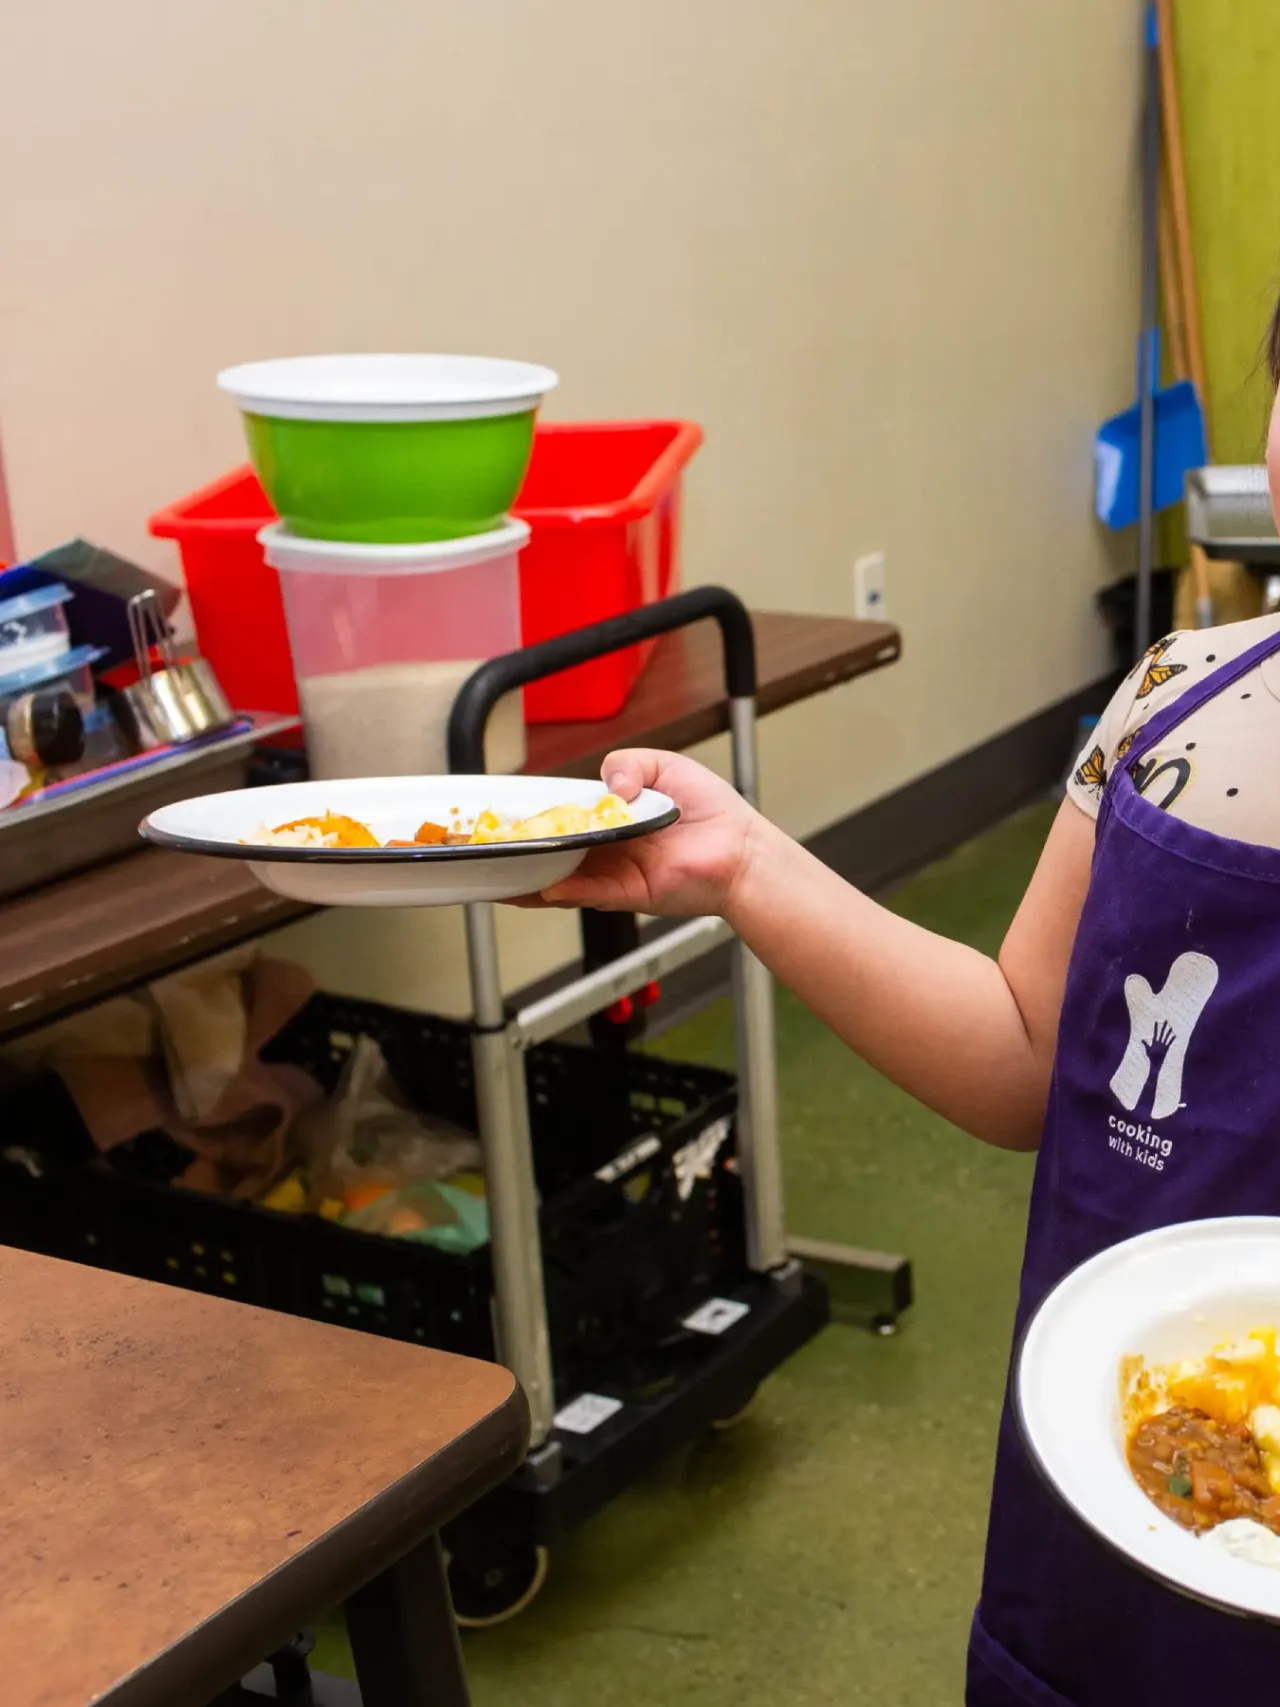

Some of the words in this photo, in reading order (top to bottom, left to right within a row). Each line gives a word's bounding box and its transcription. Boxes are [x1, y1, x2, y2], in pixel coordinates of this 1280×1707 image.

[1108, 1115, 1173, 1157] cooking
[1108, 1135, 1133, 1157] with
[1135, 1146, 1165, 1171] kids
